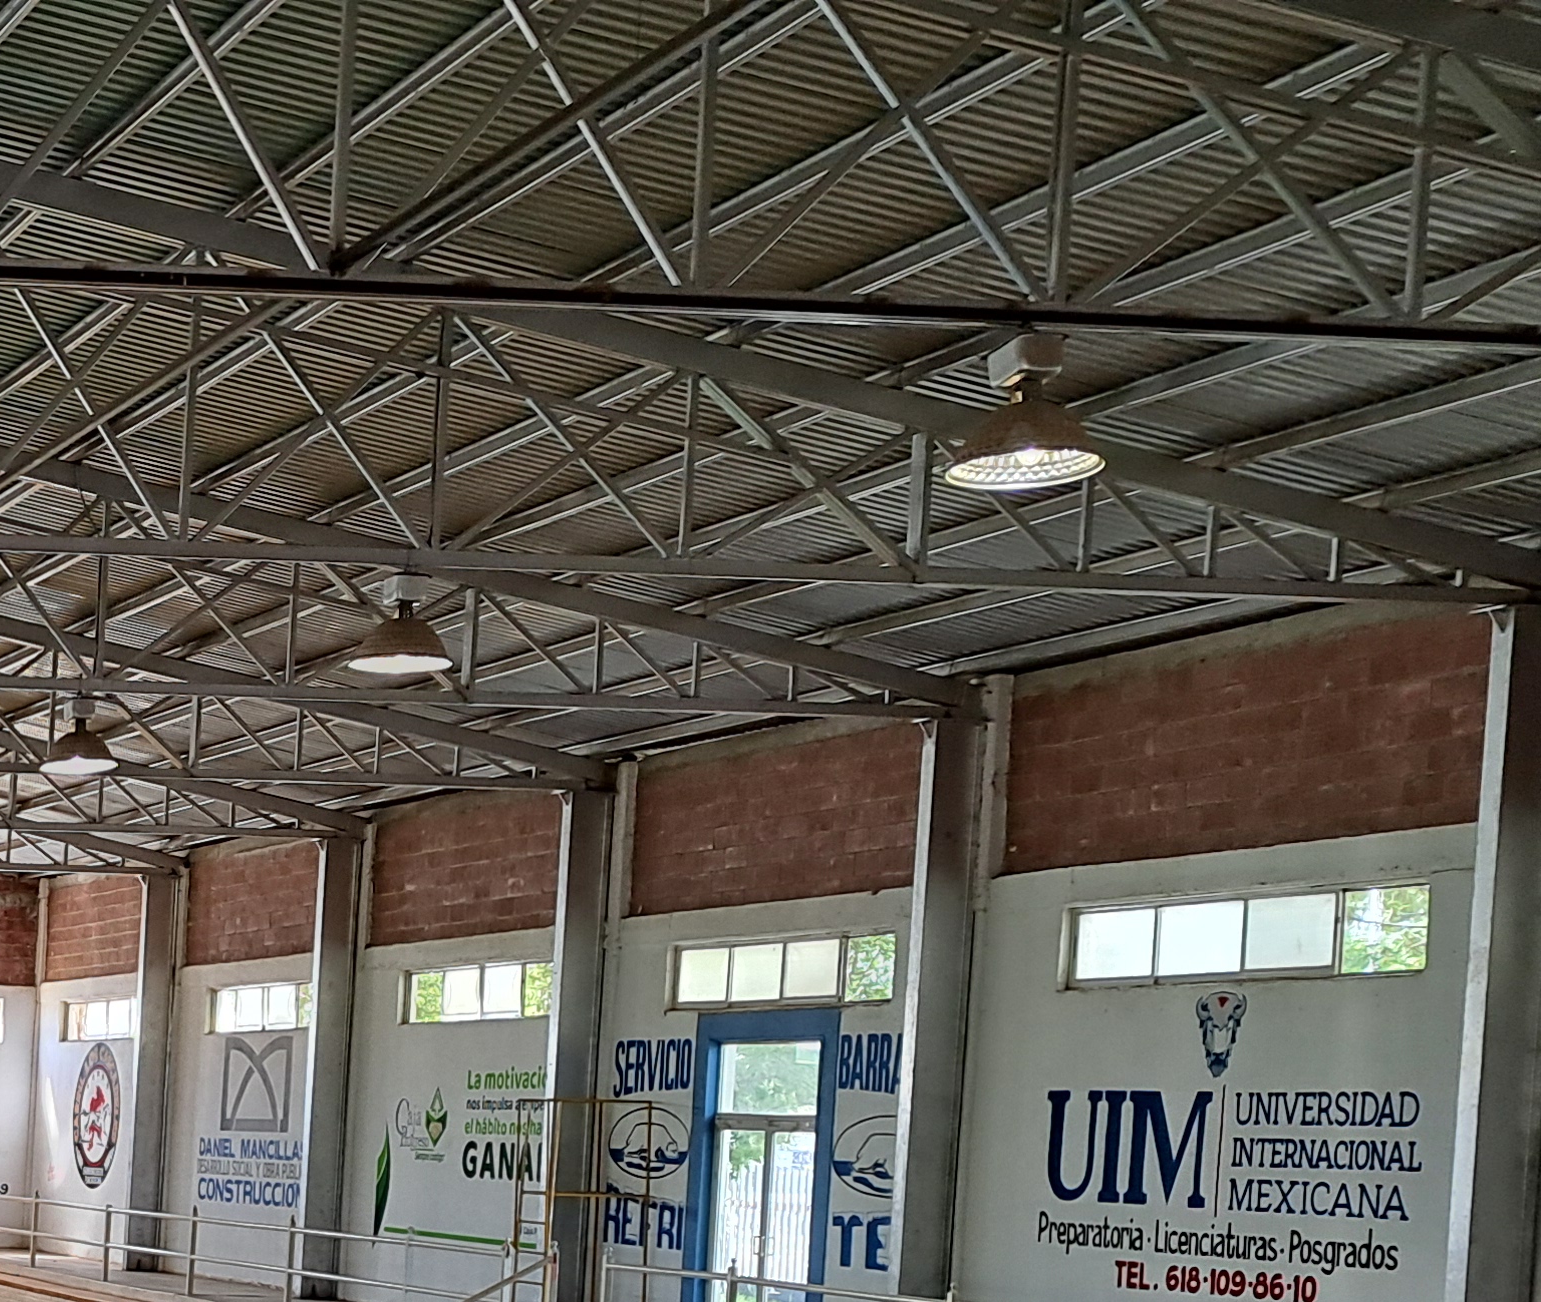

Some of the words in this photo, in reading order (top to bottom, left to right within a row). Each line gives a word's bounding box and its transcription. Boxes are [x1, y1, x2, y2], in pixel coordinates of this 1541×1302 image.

[467, 1070, 482, 1090] La
[613, 1038, 693, 1098] SERVICIO
[466, 1099, 481, 1111] nos
[1235, 1091, 1420, 1129] UNIVERSIDAD
[465, 1118, 474, 1134] el
[475, 1118, 507, 1135] hábito
[199, 1137, 235, 1158] DANIEL
[1047, 1090, 1214, 1209] UIM
[1231, 1137, 1423, 1173] INTERNACIONAL
[1228, 1179, 1410, 1222] MEXICANA
[1289, 1229, 1399, 1276] Posgrados
[1115, 1260, 1159, 1293] TEL.
